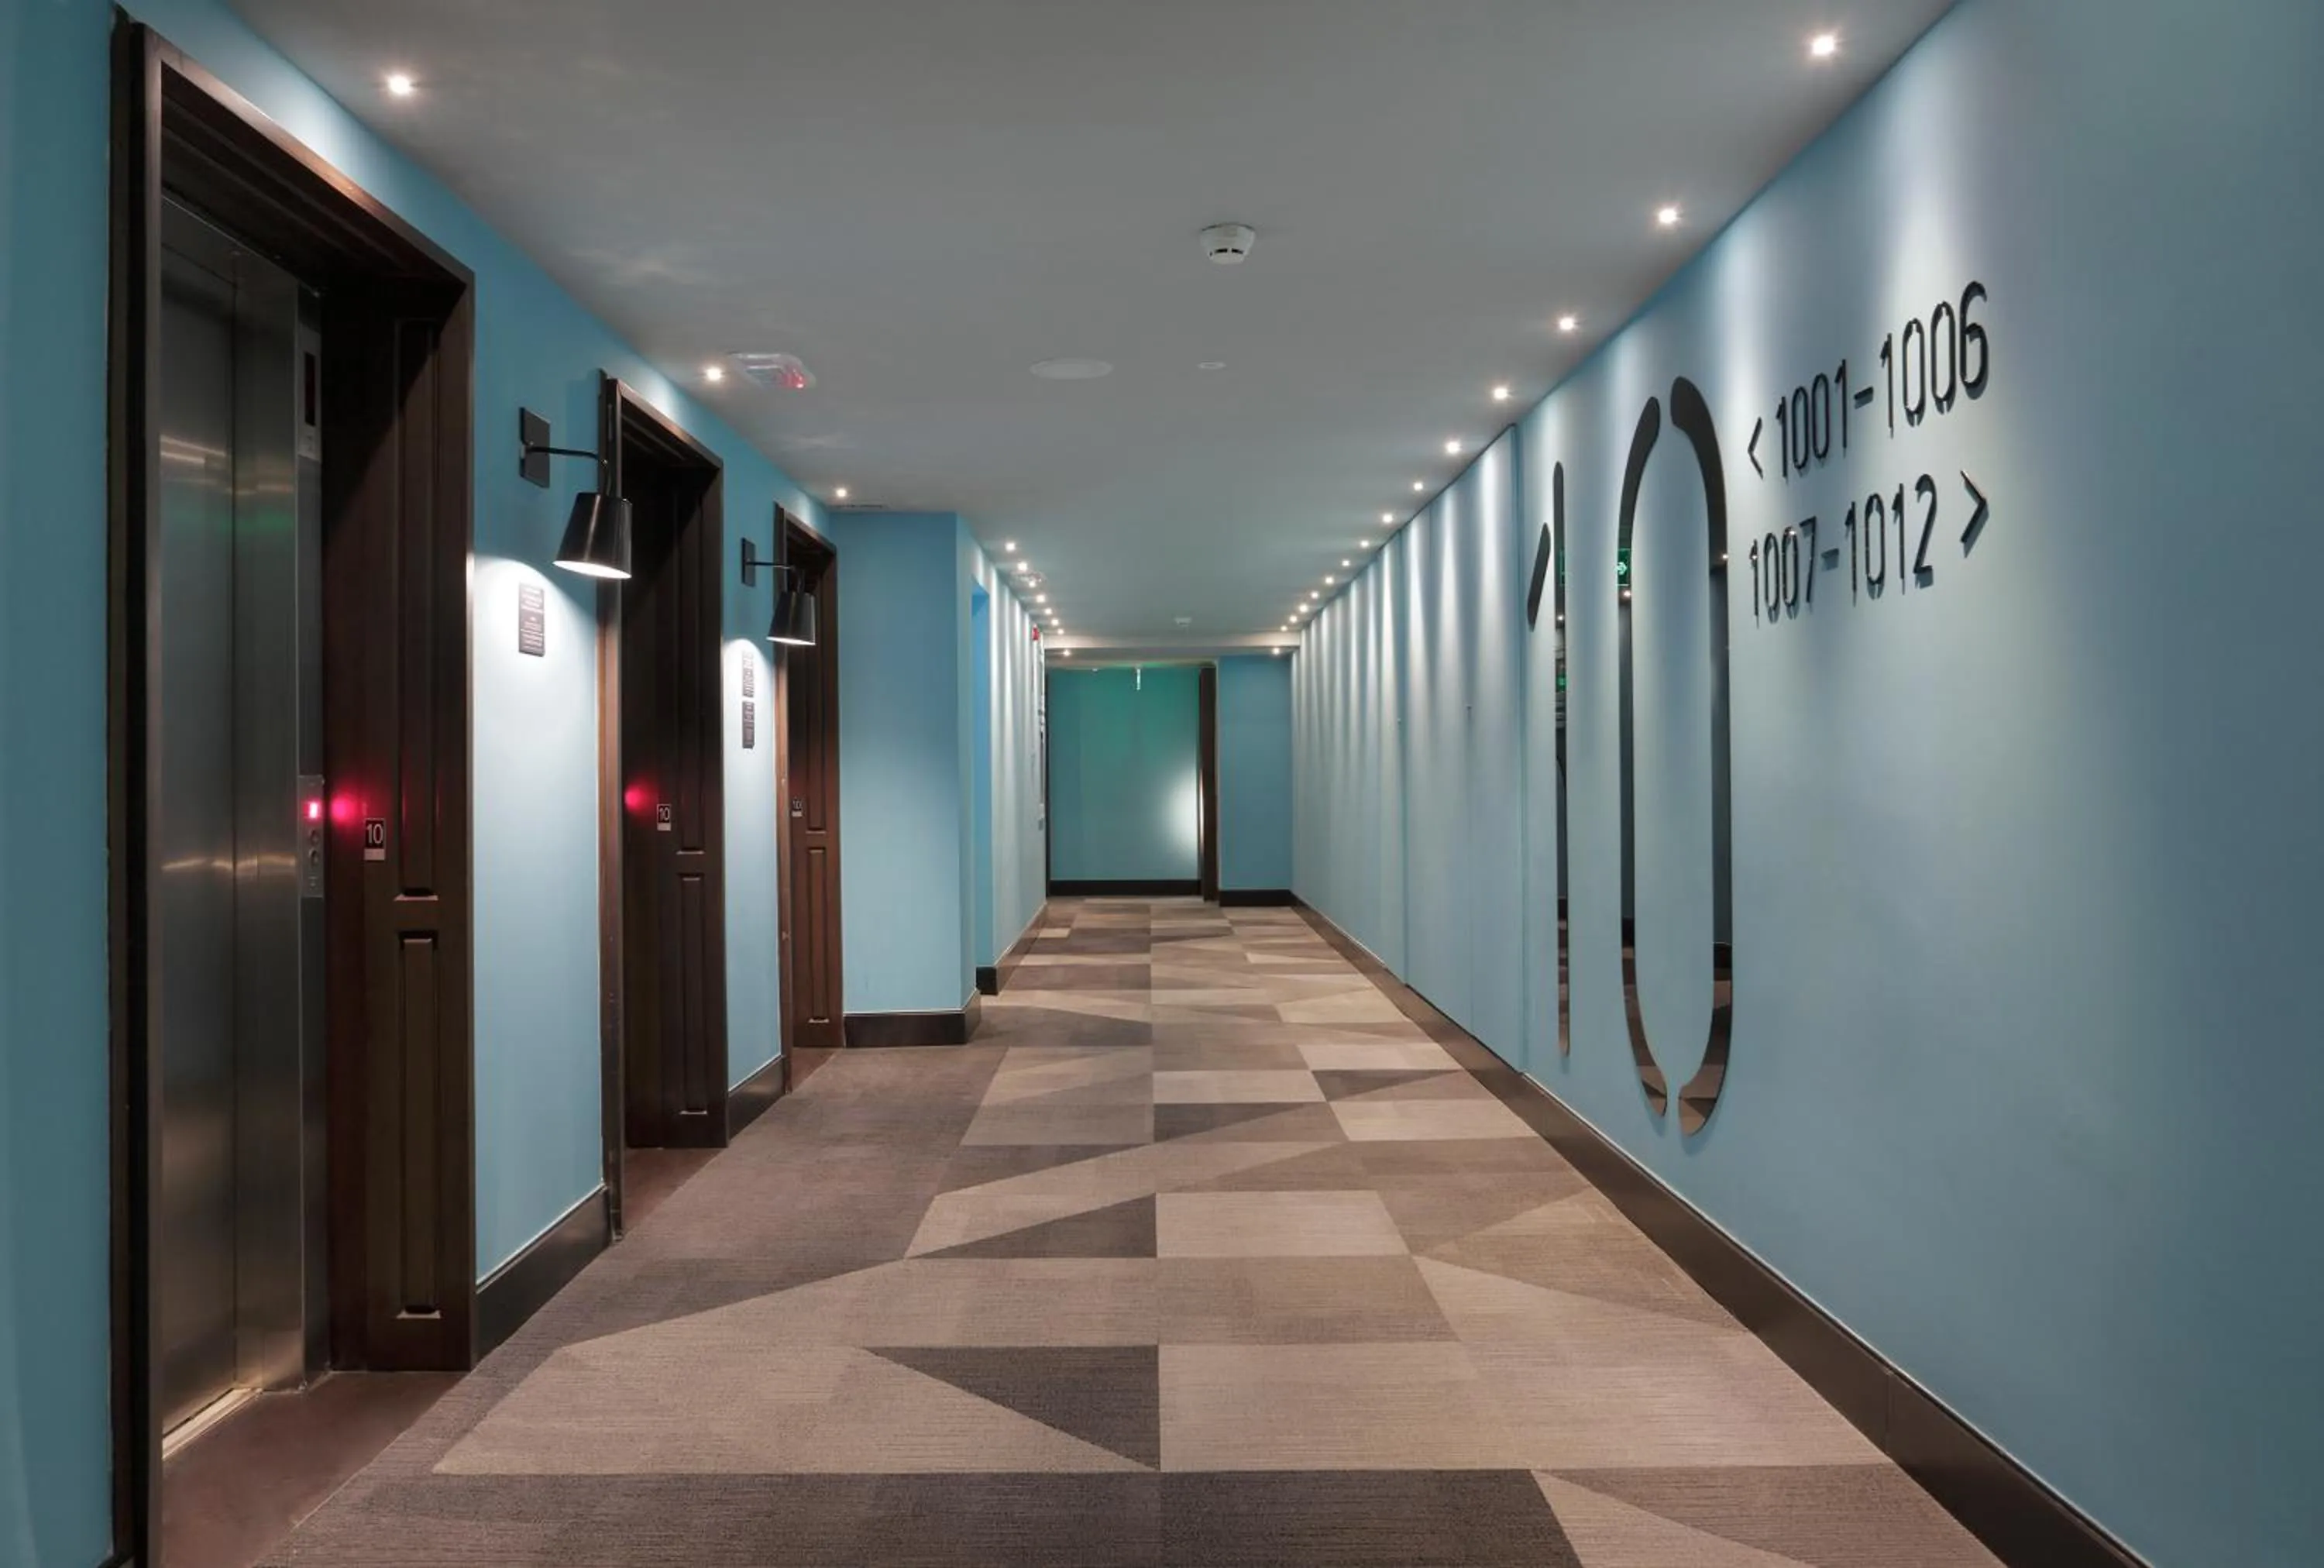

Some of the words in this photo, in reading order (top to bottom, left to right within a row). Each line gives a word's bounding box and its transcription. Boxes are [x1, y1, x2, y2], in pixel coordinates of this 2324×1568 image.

[1776, 280, 1989, 478] 1001-1006
[1749, 473, 1937, 616] 1007-1012
[366, 823, 383, 844] 10
[1527, 376, 1733, 1136] 10
